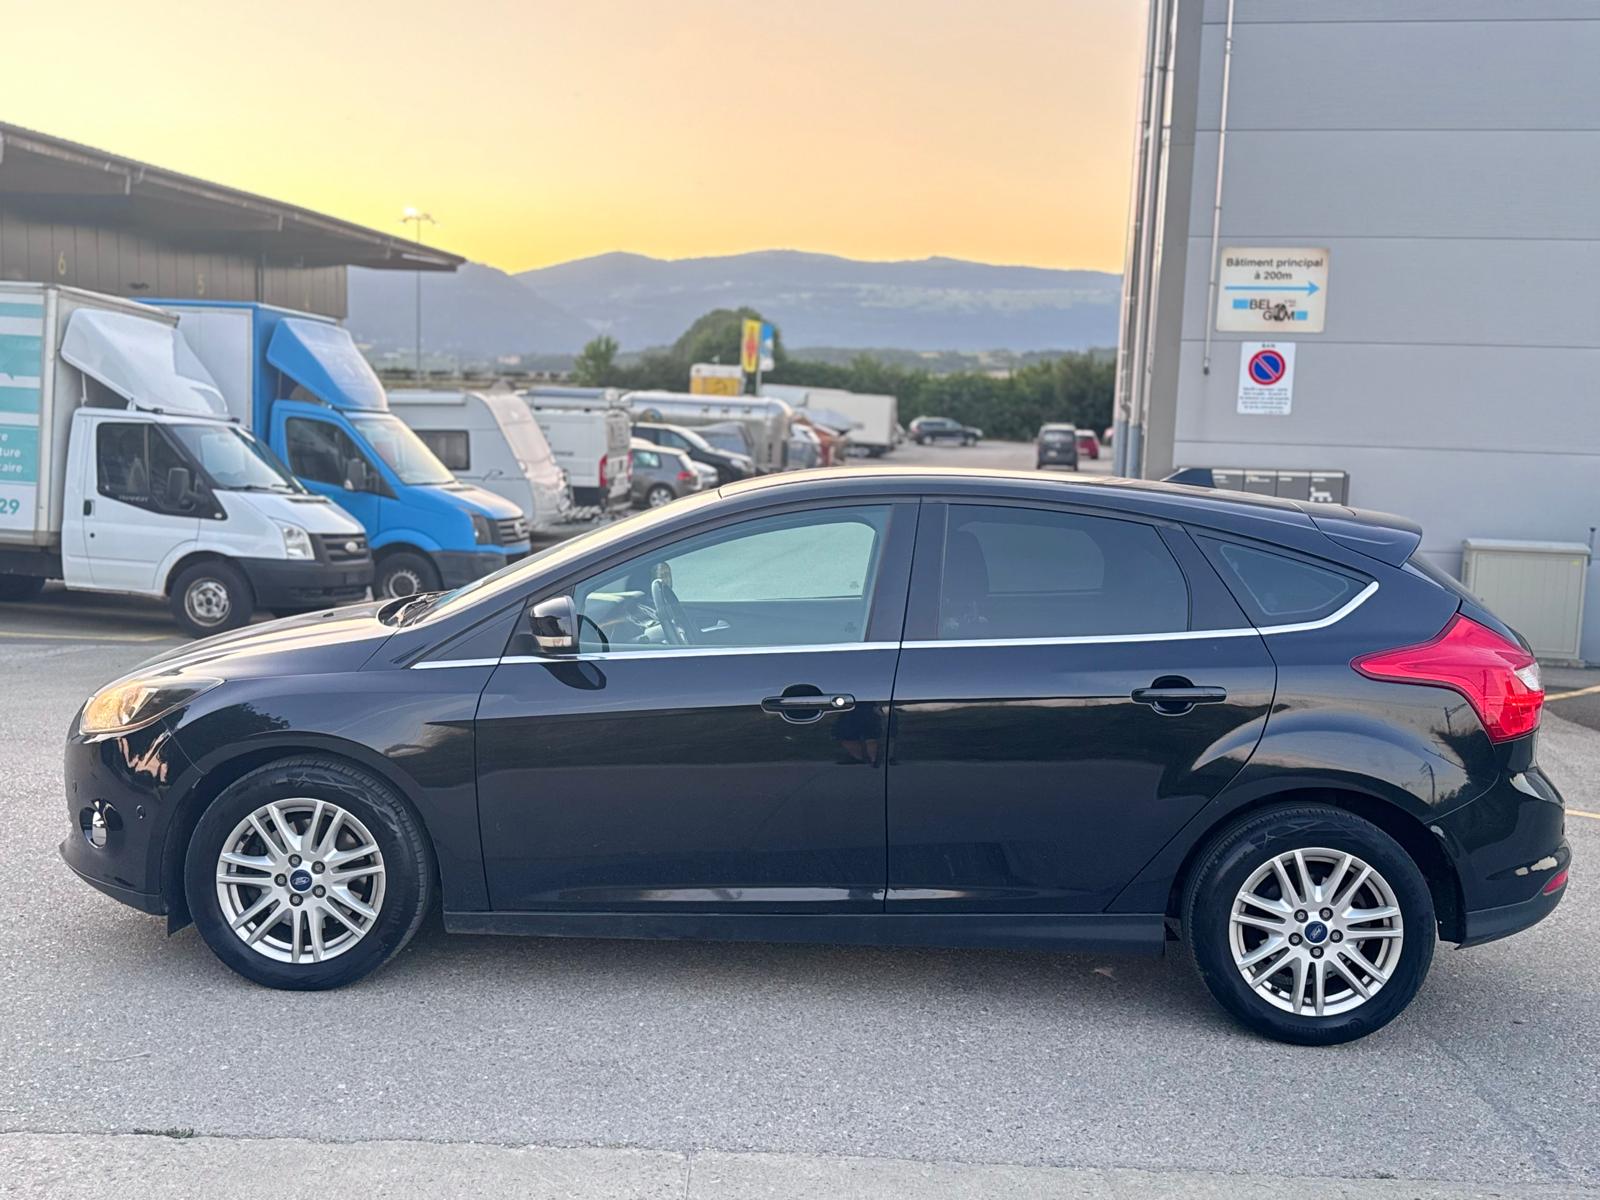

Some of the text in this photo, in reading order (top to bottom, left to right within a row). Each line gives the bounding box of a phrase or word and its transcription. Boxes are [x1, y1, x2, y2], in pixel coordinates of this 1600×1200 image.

[1226, 258, 1323, 269] Bâtiment principal
[1264, 271, 1292, 280] 200m
[1249, 299, 1273, 310] BEL
[0, 462, 23, 473] aire
